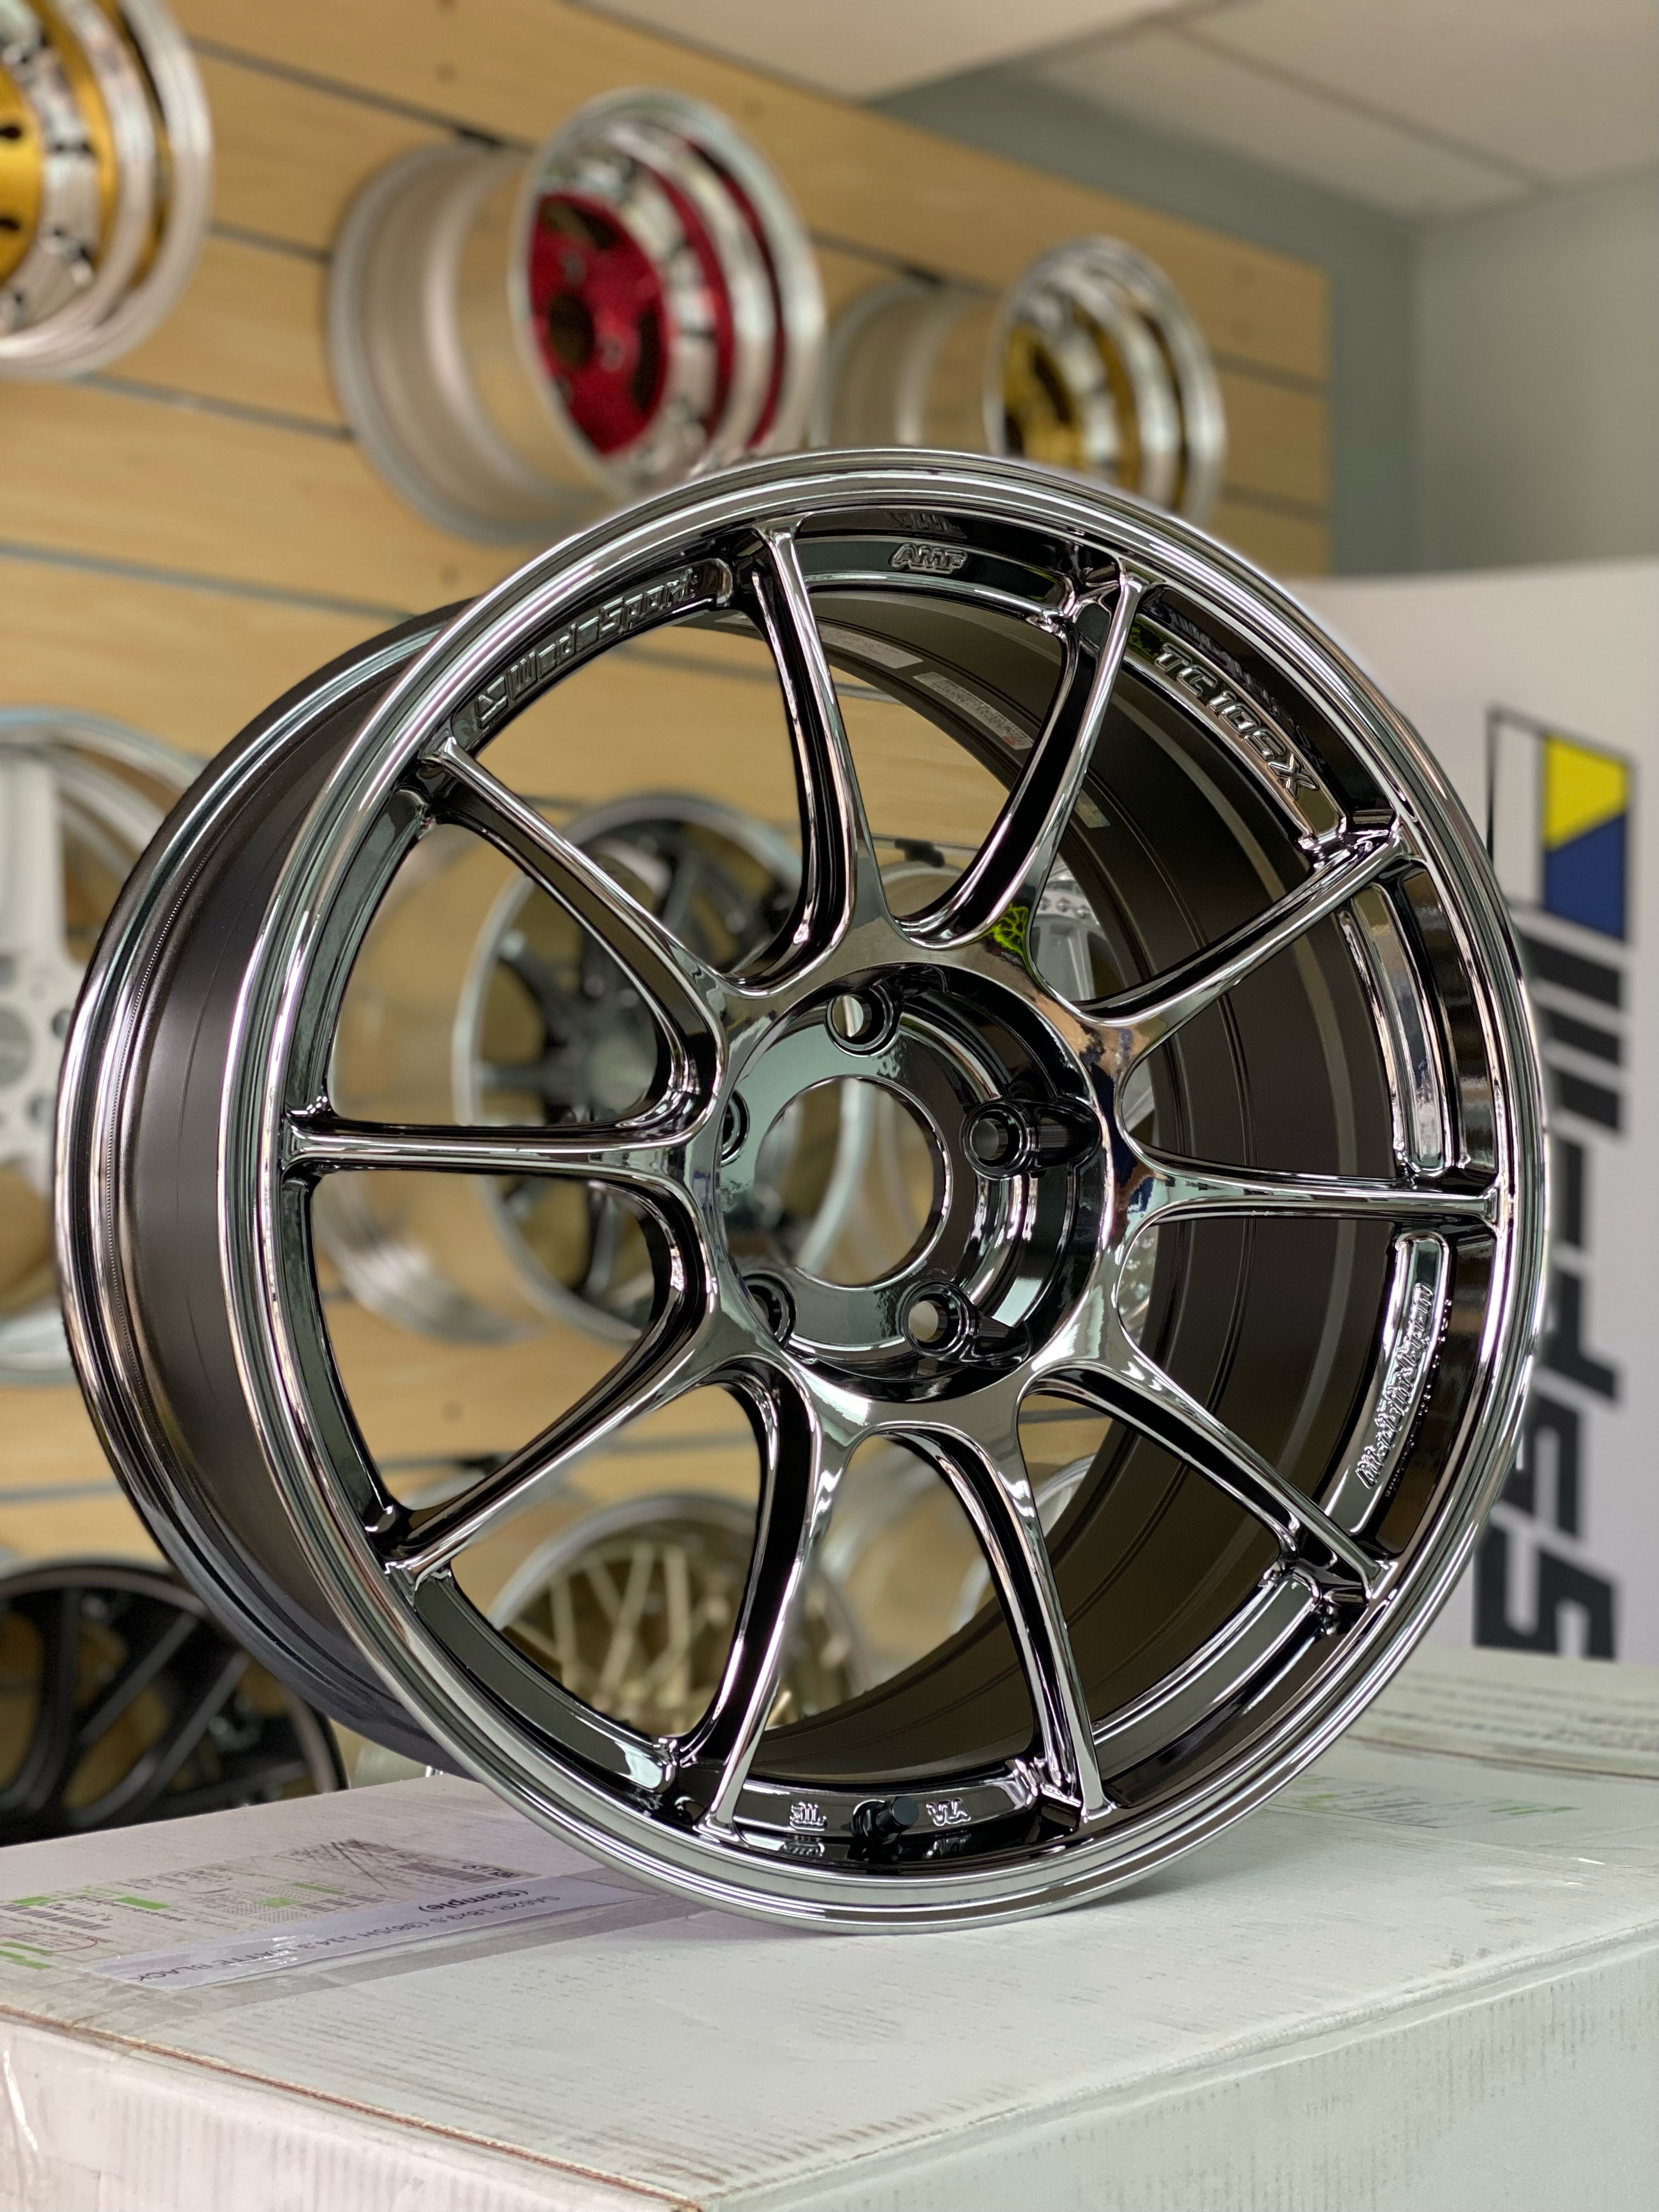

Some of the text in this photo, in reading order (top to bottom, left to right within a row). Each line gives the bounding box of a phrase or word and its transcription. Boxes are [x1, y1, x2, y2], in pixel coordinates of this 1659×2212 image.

[888, 542, 968, 574] AMF
[419, 1888, 528, 1913] (Sample)
[127, 1963, 212, 1982] BLACK
